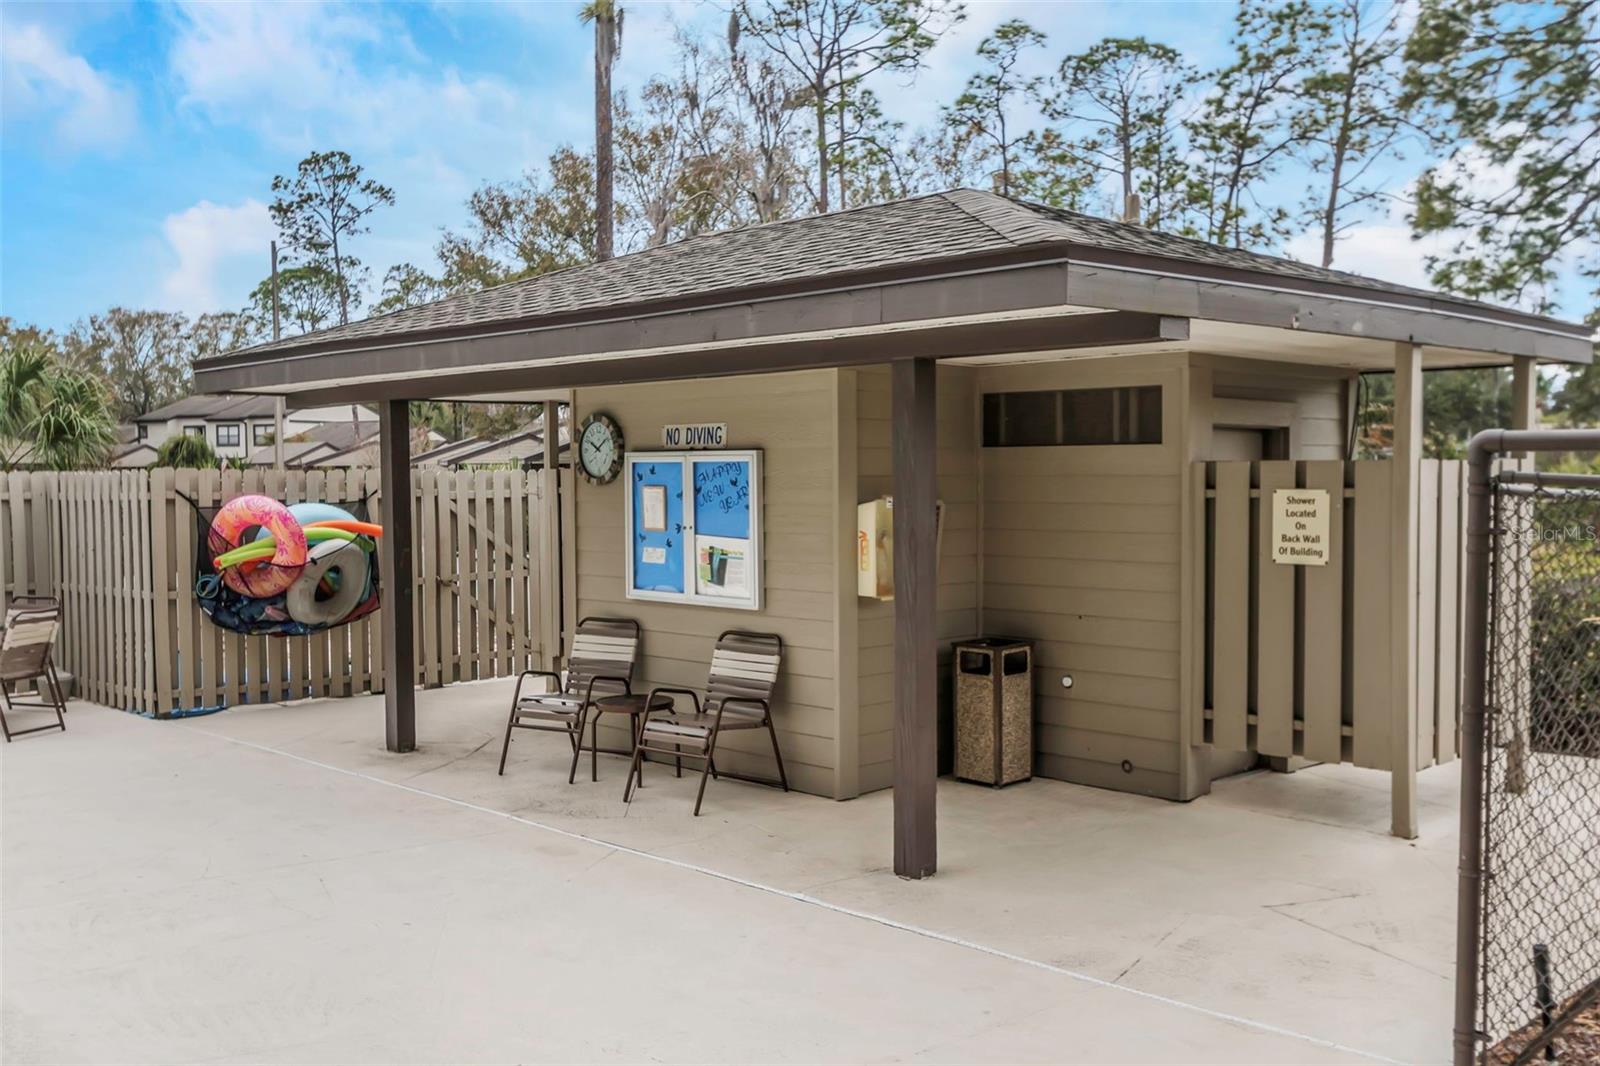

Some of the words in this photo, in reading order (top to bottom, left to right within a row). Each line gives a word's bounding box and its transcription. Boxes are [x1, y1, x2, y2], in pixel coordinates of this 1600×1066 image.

[666, 428, 680, 445] NO
[686, 426, 722, 445] DIVING
[697, 462, 741, 484] HAPPY
[700, 481, 724, 507] NEW
[1286, 496, 1316, 505] Shower
[1285, 509, 1317, 518] Located
[1295, 521, 1307, 530] On
[1281, 534, 1301, 543] Back
[1302, 535, 1321, 543] Wall
[1278, 546, 1288, 555] Of
[1290, 547, 1323, 558] Building
